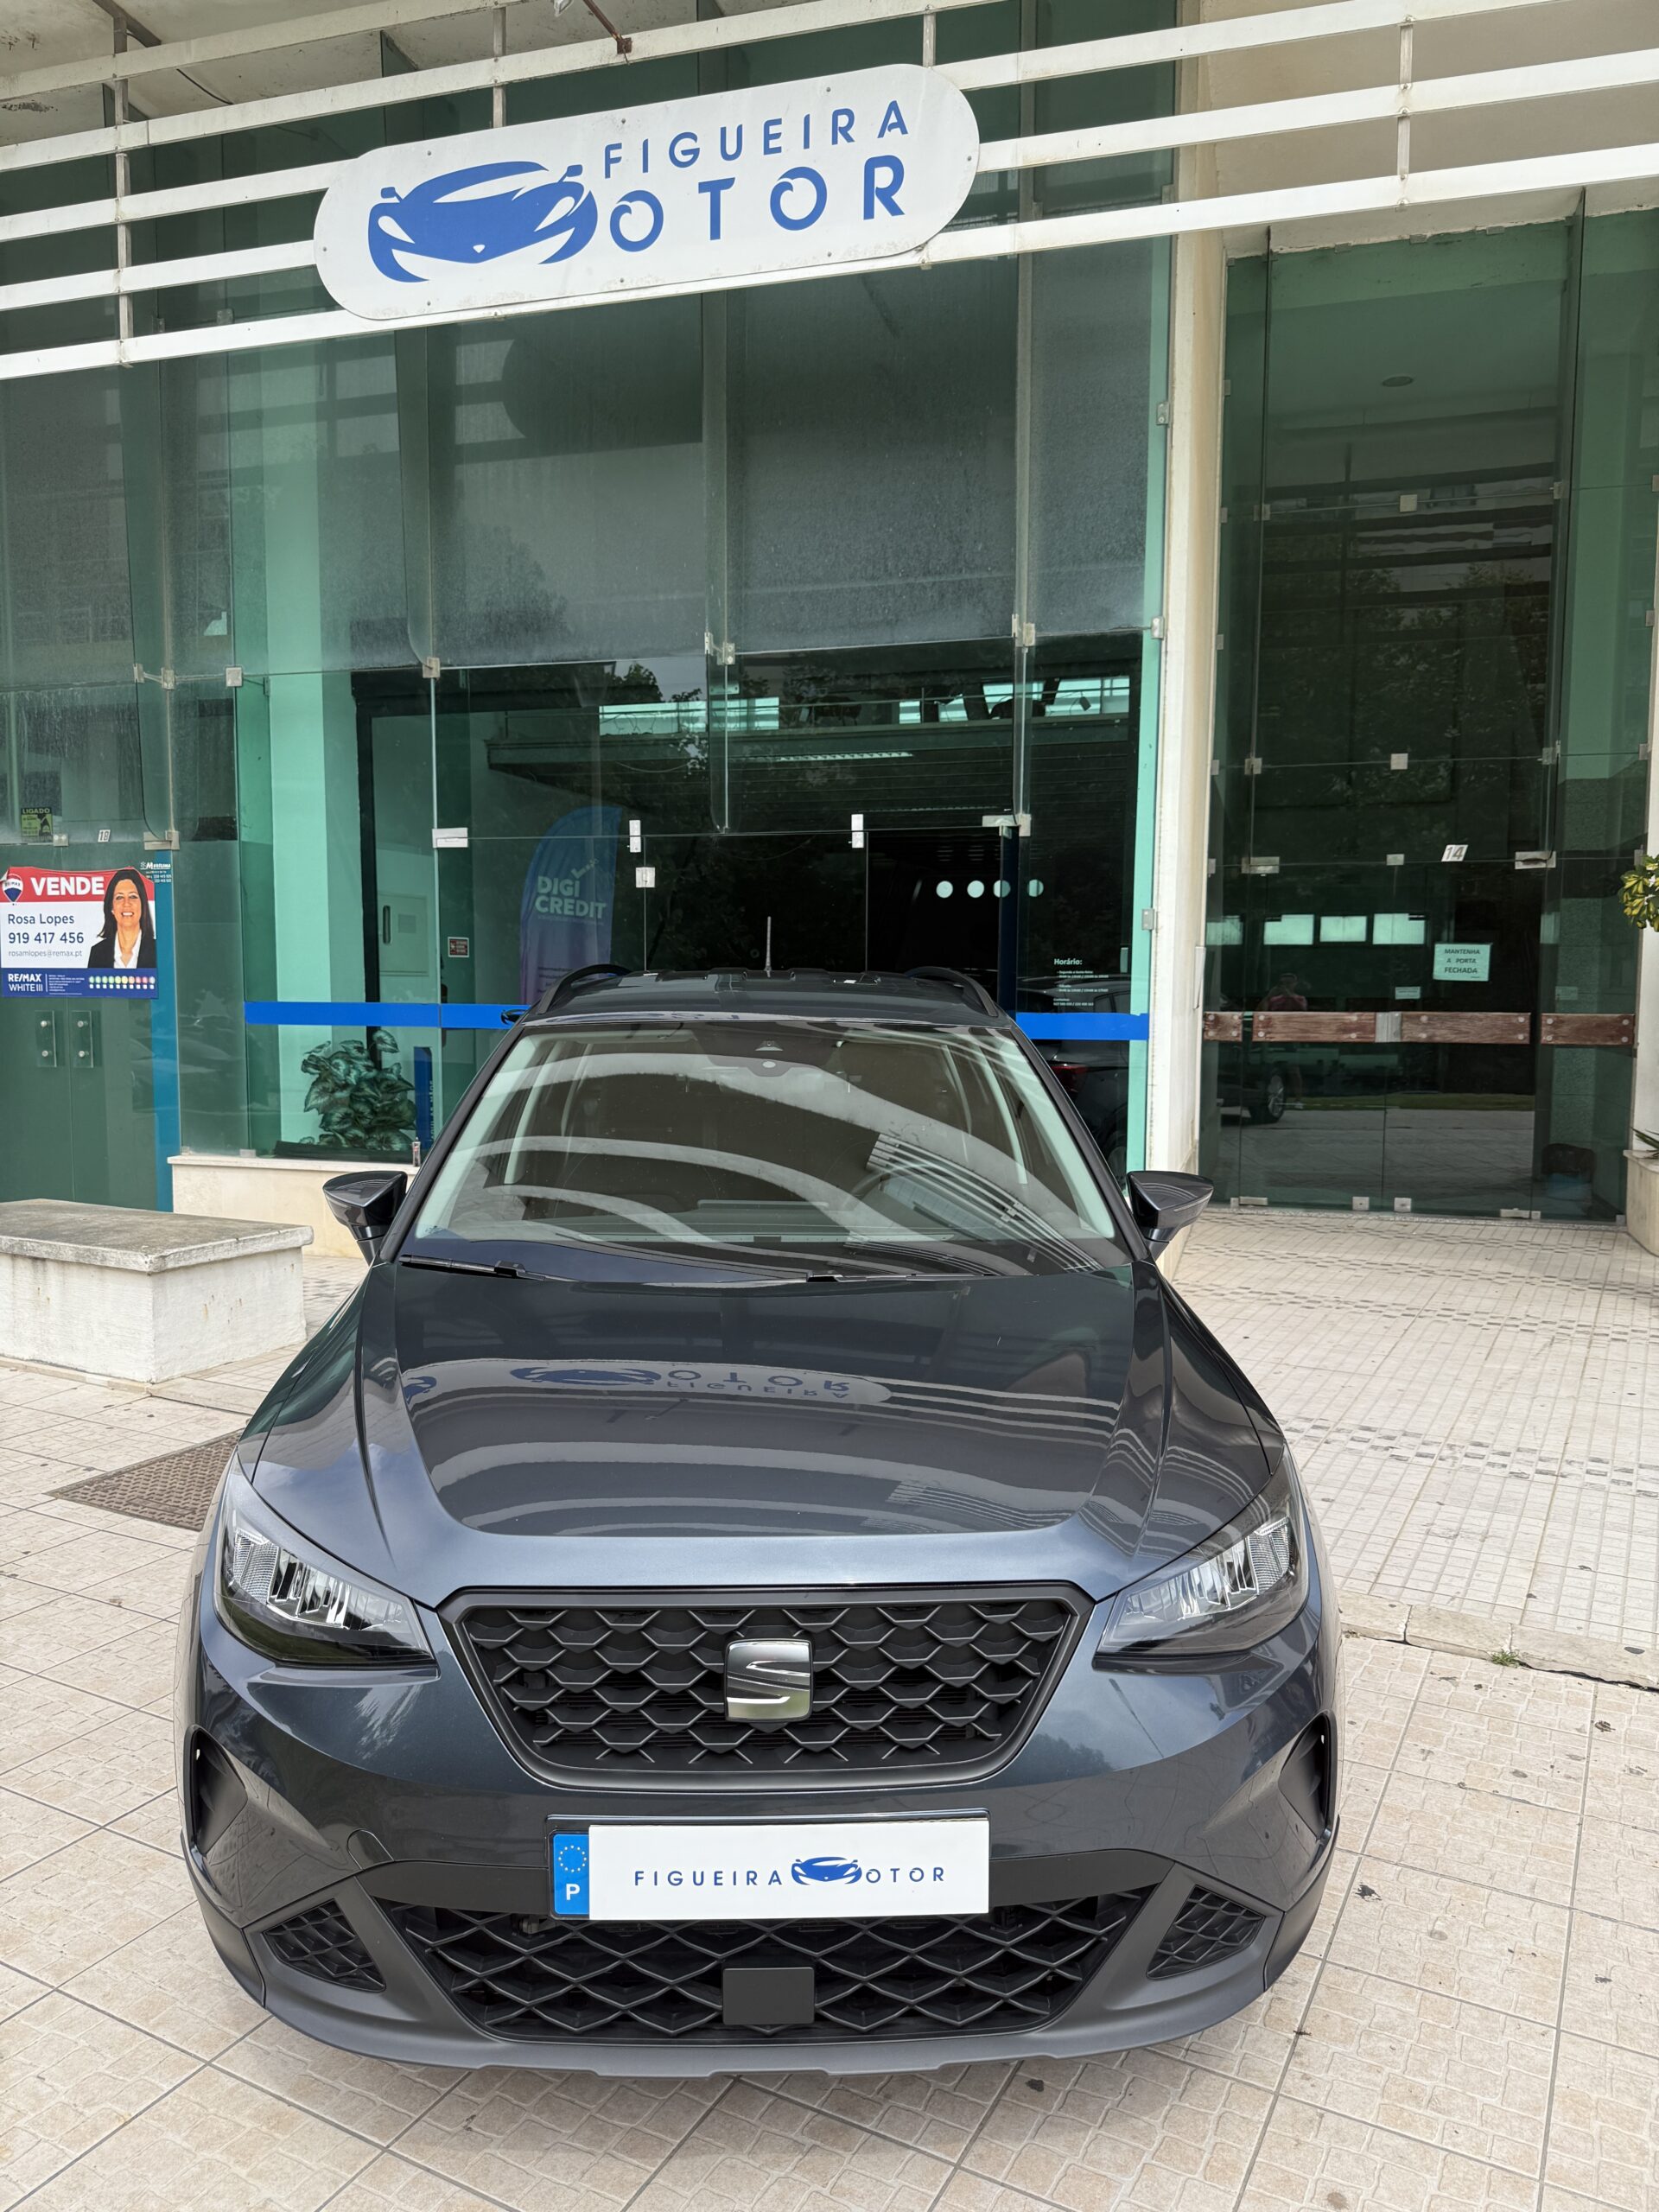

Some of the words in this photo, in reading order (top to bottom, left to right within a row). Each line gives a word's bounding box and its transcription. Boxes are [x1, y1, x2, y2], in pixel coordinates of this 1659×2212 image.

[605, 100, 908, 179] FIGUEIRA
[99, 831, 109, 841] 18
[1446, 847, 1464, 860] 14
[31, 876, 105, 896] VENDE
[537, 875, 580, 897] DIGI
[535, 895, 607, 919] CREDIT
[8, 913, 35, 925] Rosa
[40, 913, 74, 926] Lopes
[8, 932, 29, 944] 919
[34, 932, 54, 944] 417
[60, 932, 84, 944] 456
[1053, 957, 1083, 966] Horário:
[1444, 966, 1478, 975] FECHADA
[8, 973, 41, 982] RE/MAX
[9, 983, 35, 992] WHITE
[634, 1868, 783, 1887] FIGUEIRA
[566, 1883, 581, 1901] P
